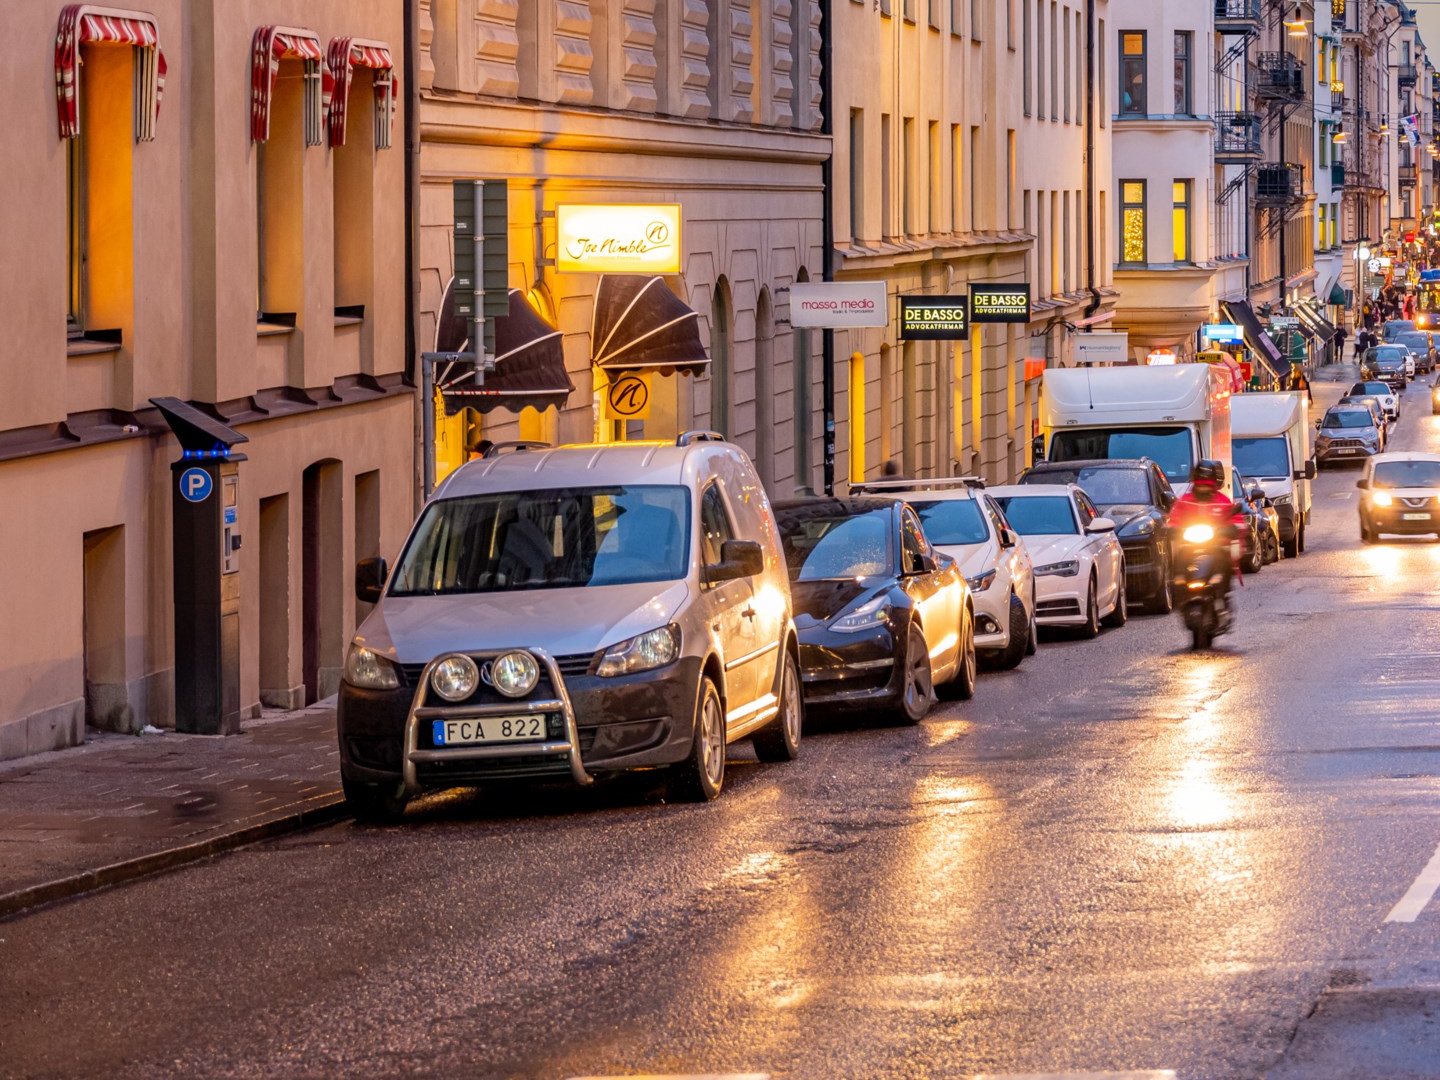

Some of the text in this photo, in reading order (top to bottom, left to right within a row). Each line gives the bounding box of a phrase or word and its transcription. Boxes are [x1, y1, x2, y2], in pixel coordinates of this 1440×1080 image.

[566, 238, 670, 259] Joe Nimble
[802, 299, 875, 310] massa media
[975, 295, 1027, 305] DE BASSO
[905, 309, 964, 320] DE BASSO
[447, 721, 485, 741] FCA
[501, 718, 541, 738] 822
